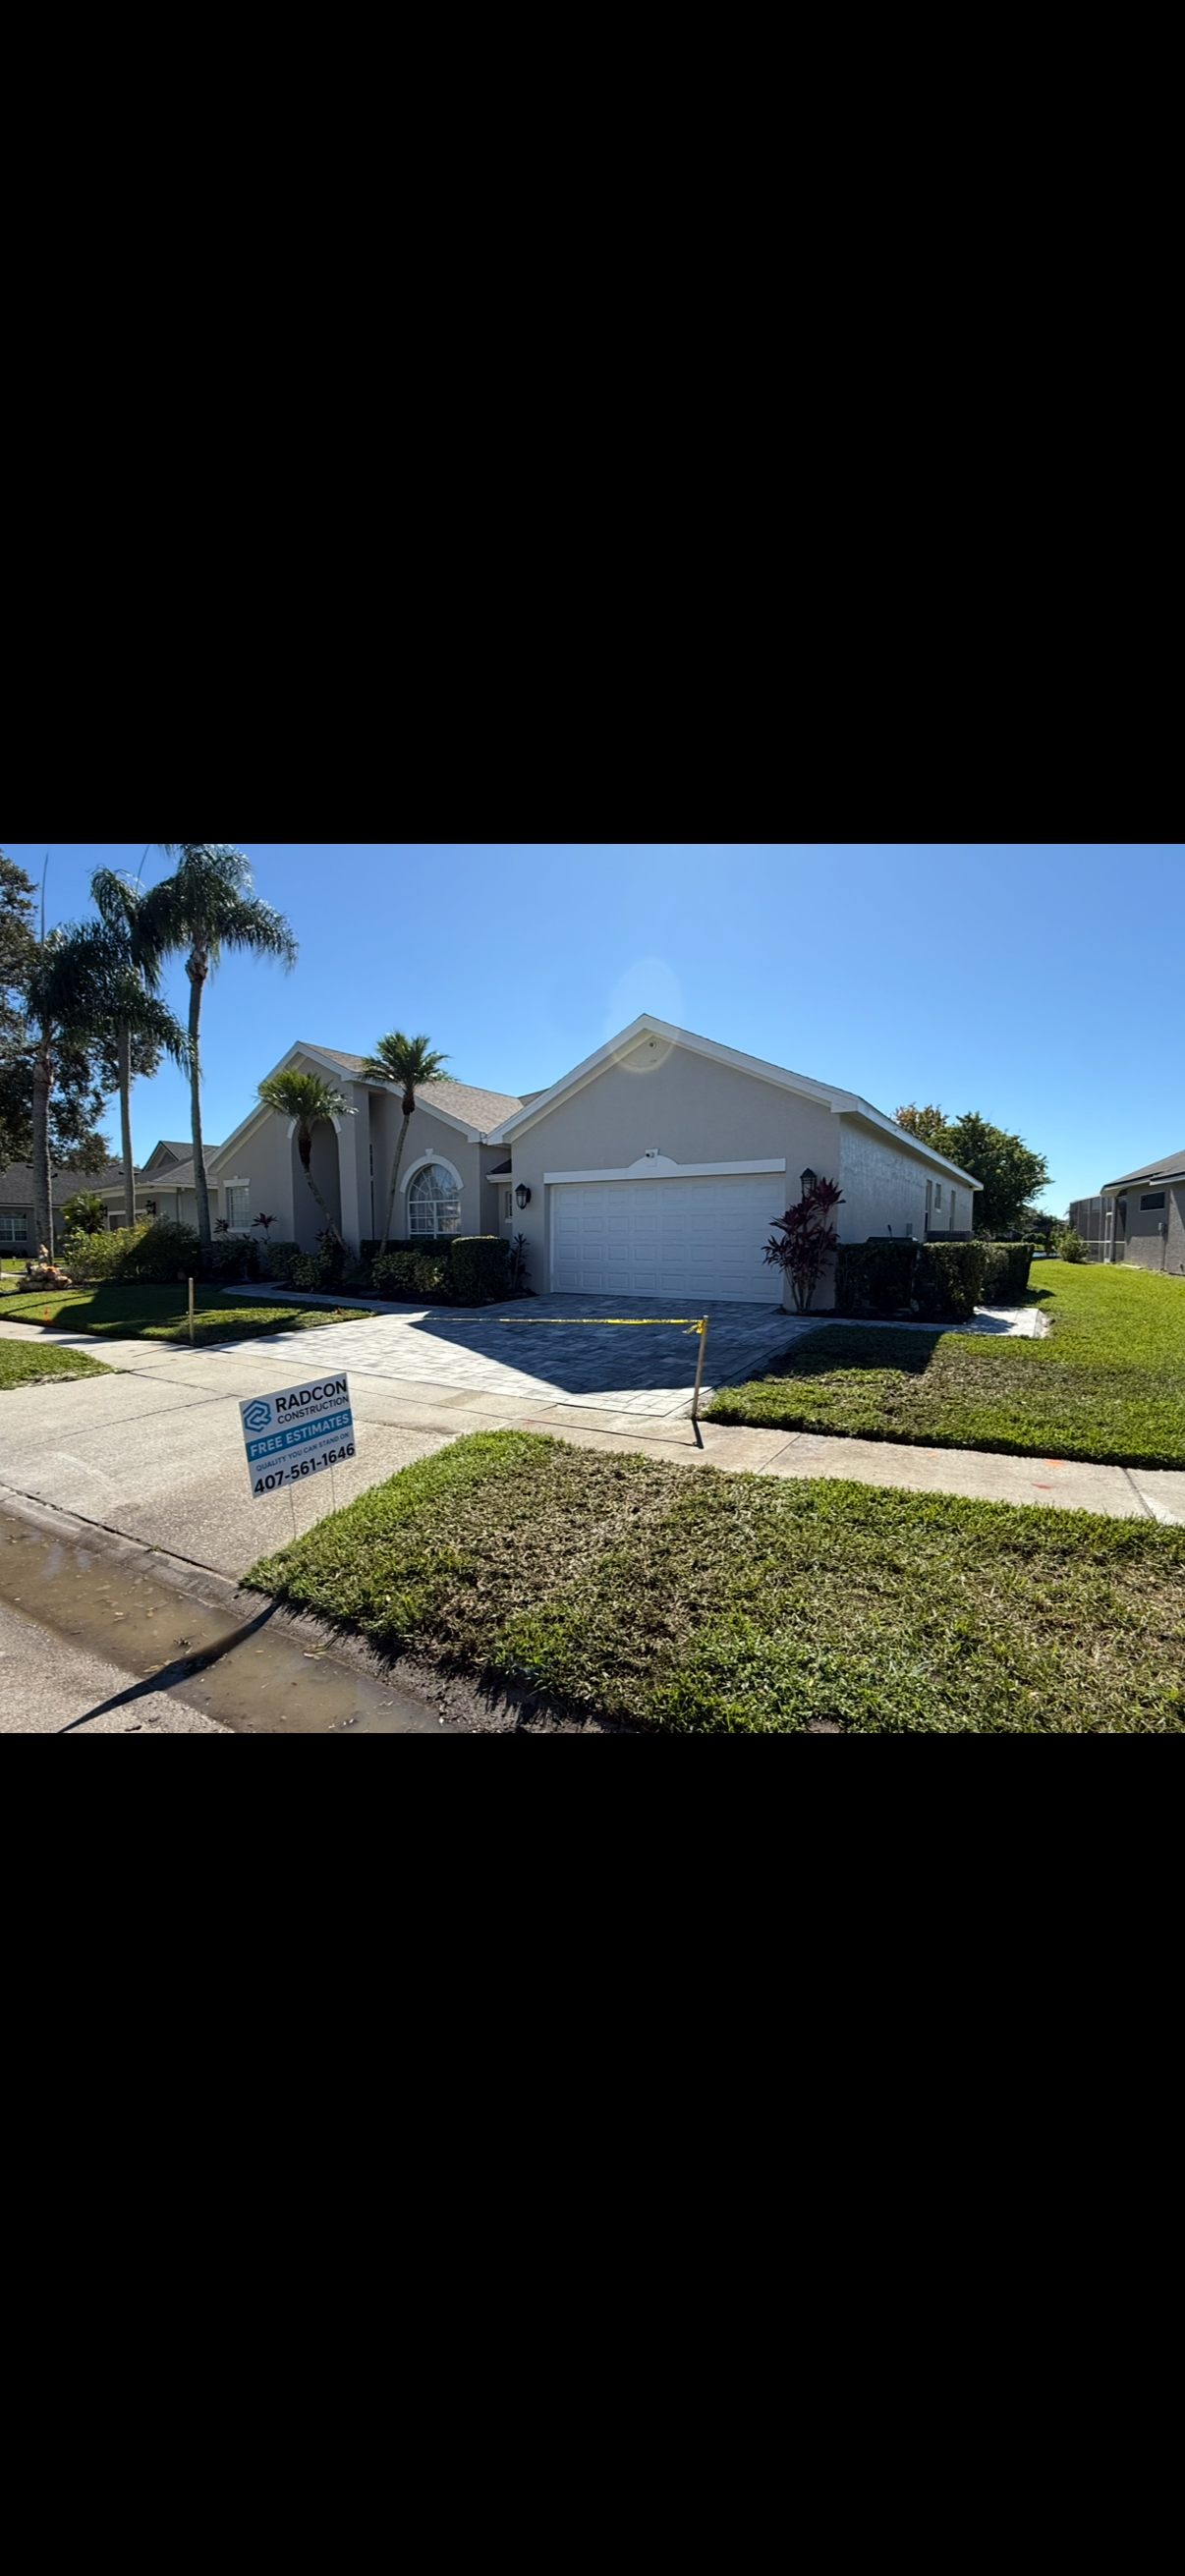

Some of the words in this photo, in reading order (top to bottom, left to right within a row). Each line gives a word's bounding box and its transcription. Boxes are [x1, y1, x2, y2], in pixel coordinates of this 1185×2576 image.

[275, 1379, 348, 1413] RADCON
[277, 1396, 349, 1424] CONSTRUCTION
[250, 1436, 283, 1456] FREE
[286, 1413, 350, 1444] ESTIMATES
[254, 1442, 355, 1493] 407-561-1646
[255, 1455, 286, 1472] QUALITY
[289, 1449, 303, 1459] YOU
[303, 1444, 317, 1454] CAN
[318, 1435, 339, 1448] STAND
